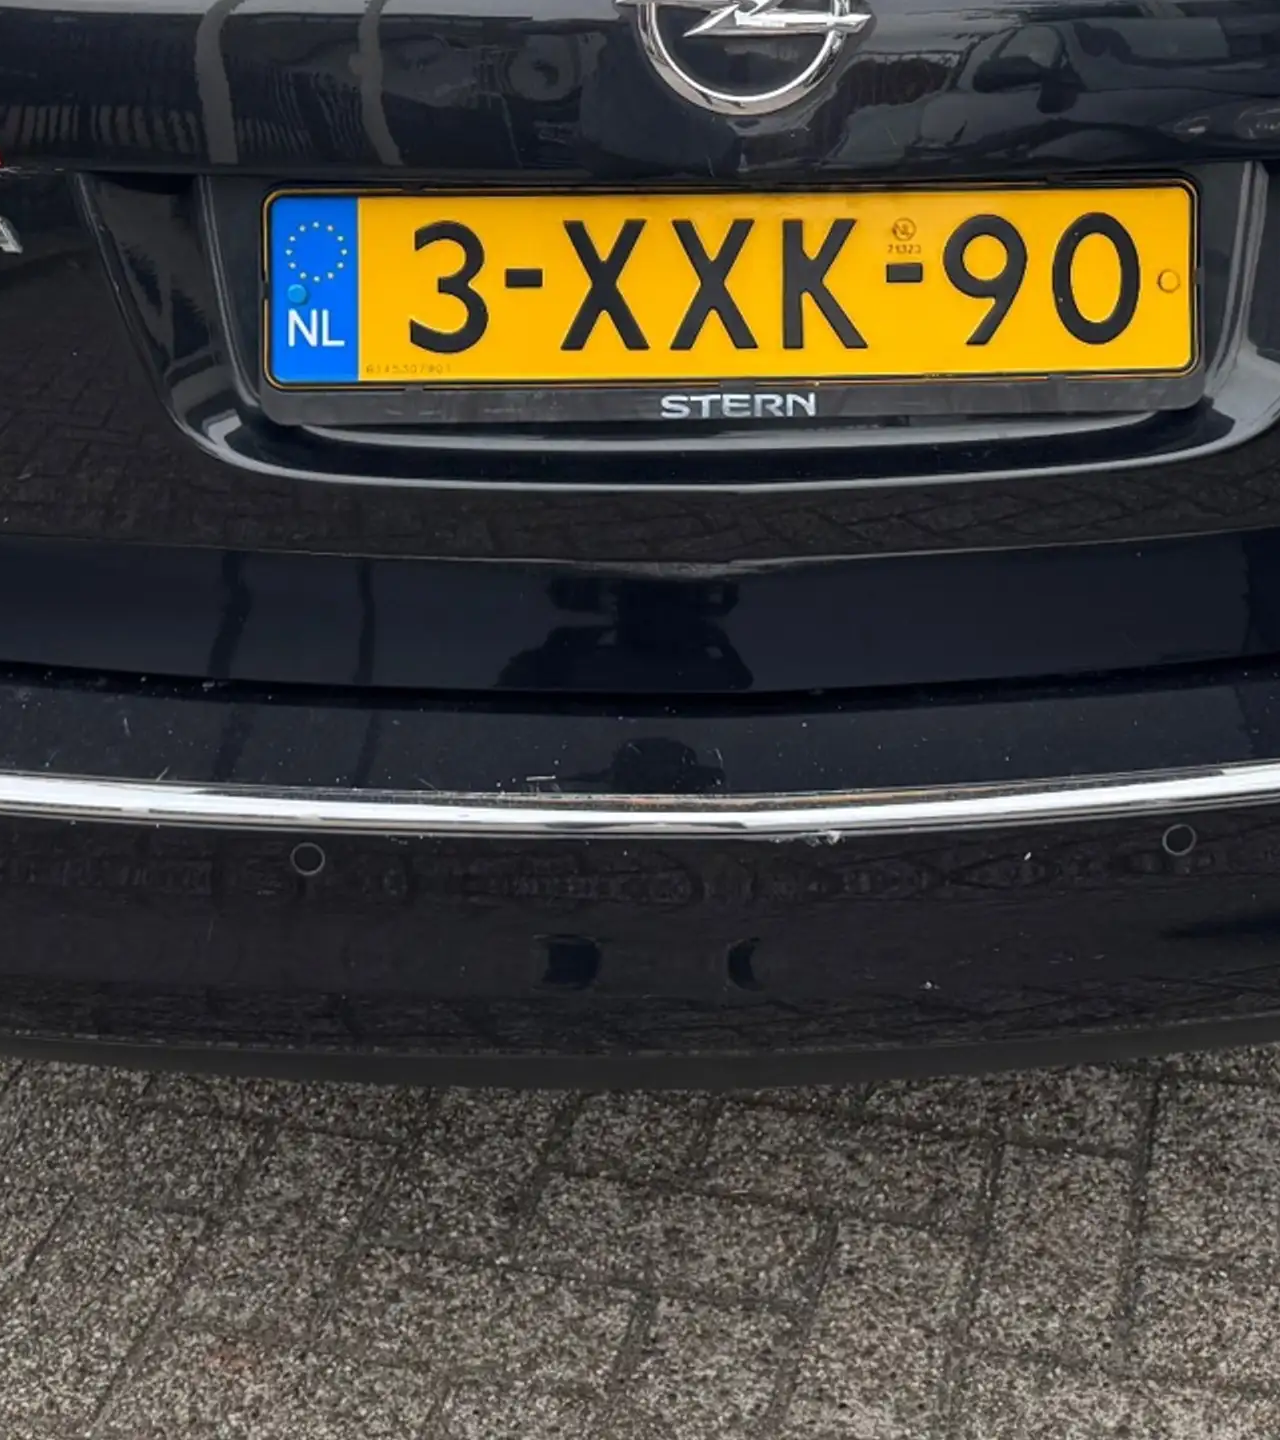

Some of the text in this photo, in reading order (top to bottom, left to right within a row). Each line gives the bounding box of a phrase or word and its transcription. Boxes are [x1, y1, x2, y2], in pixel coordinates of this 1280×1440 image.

[408, 211, 1141, 355] 3-XXK-90
[287, 309, 345, 348] NL
[660, 393, 816, 418] STERN
